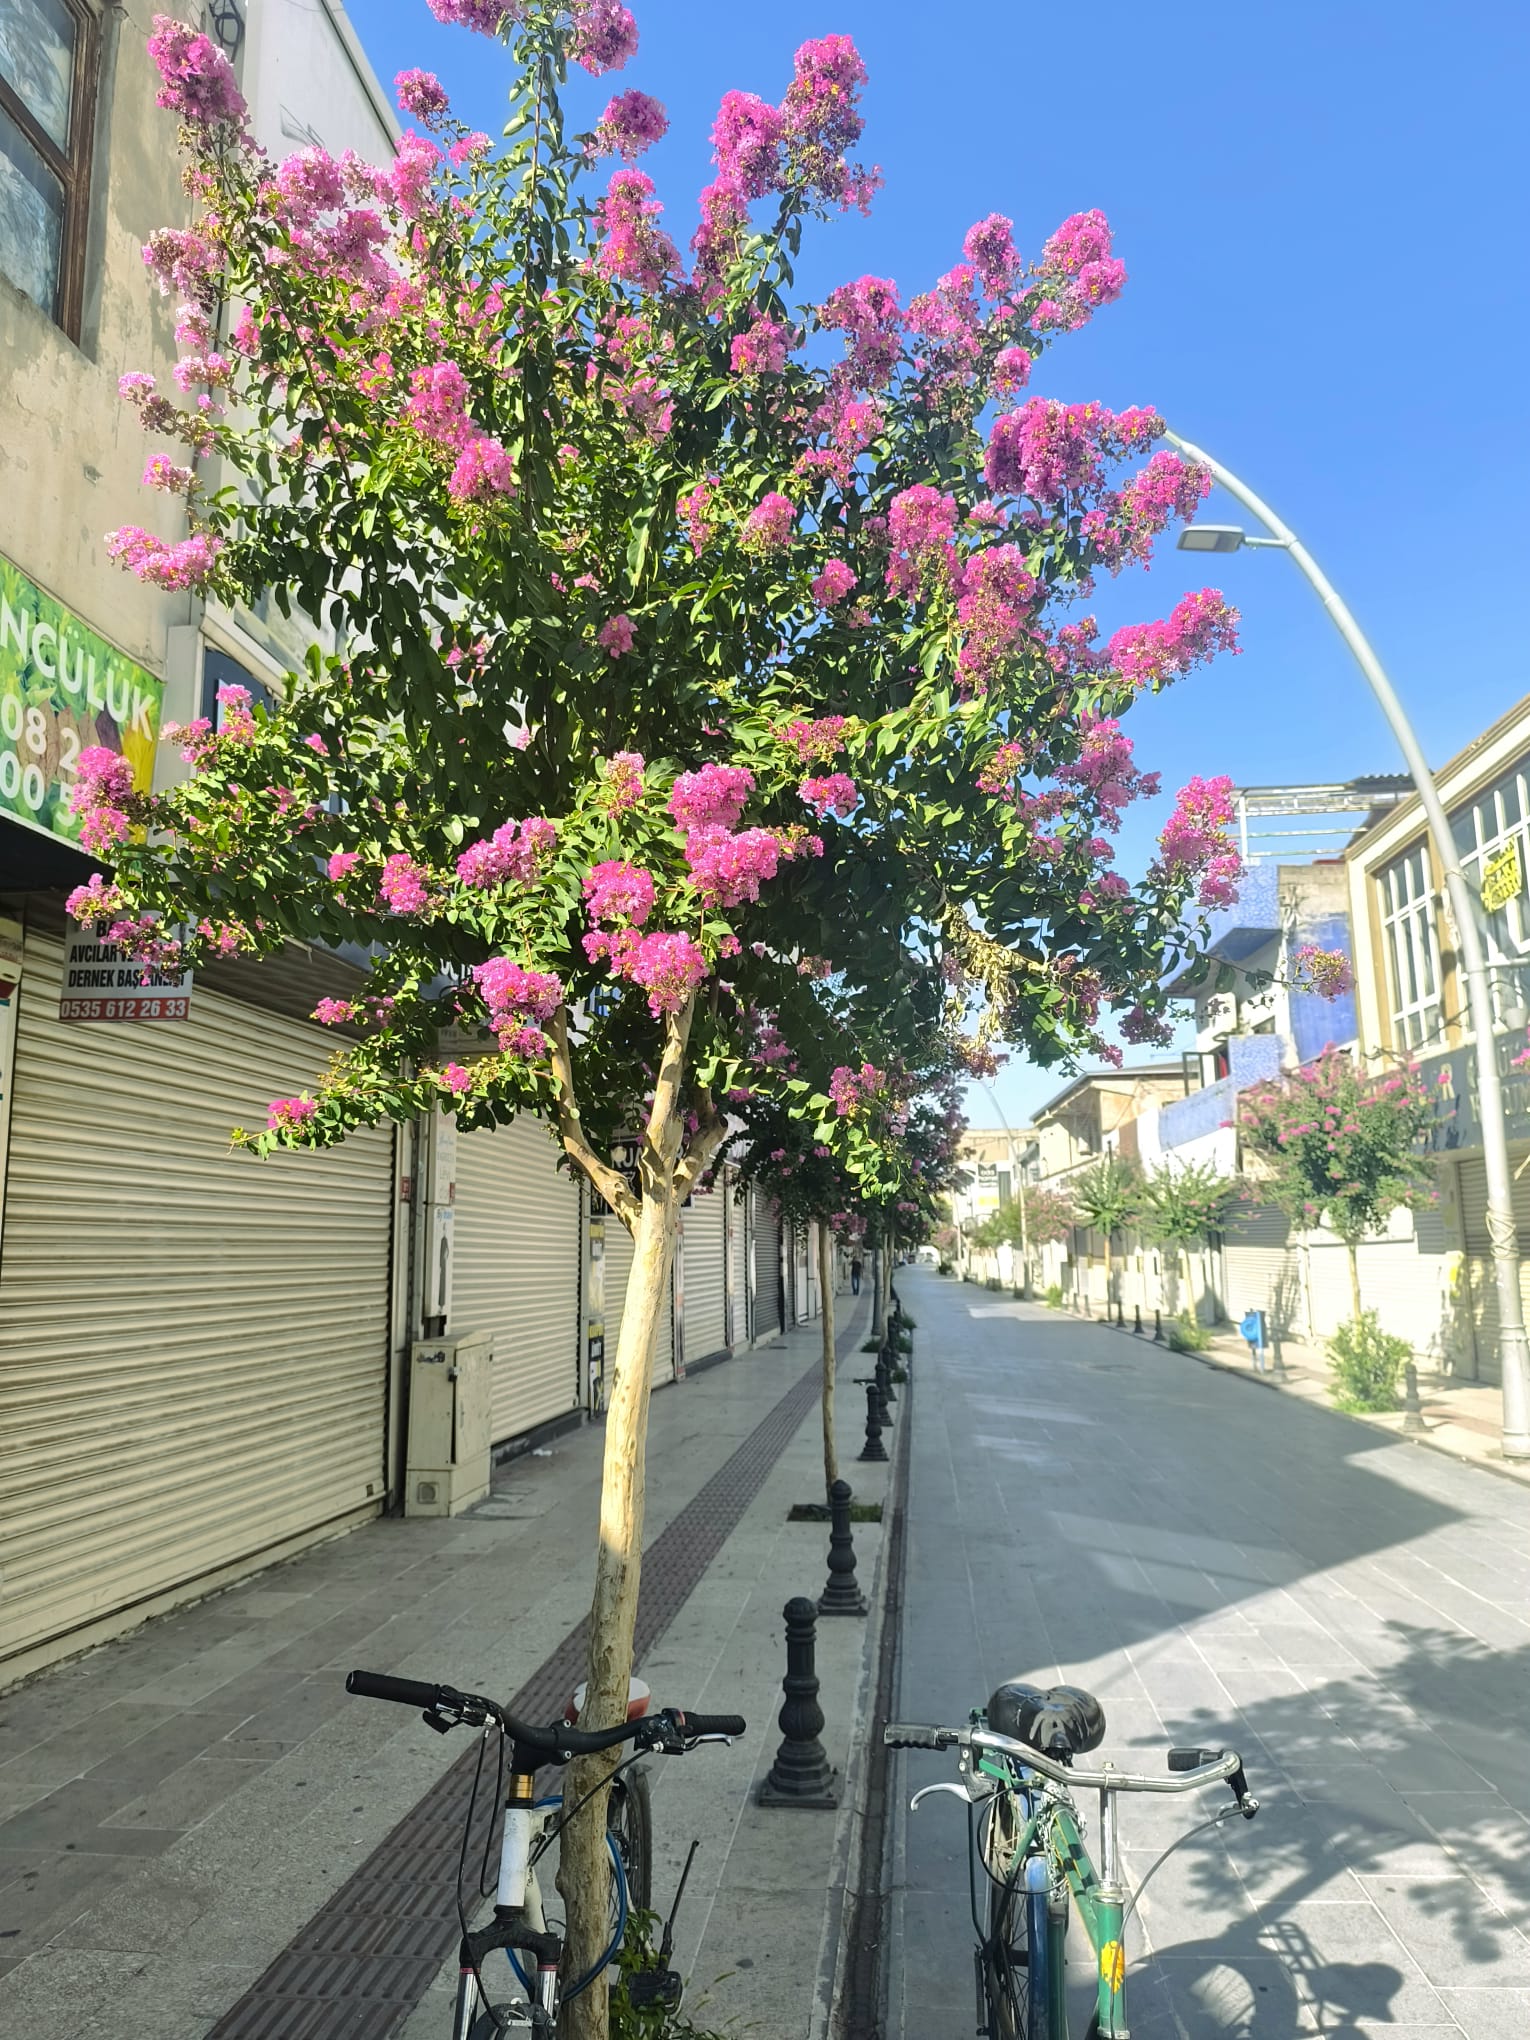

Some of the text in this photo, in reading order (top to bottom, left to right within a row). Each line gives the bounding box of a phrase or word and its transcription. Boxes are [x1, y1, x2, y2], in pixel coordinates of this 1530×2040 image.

[69, 944, 118, 963] AVCILAR
[68, 969, 114, 988] DERNEK
[61, 999, 186, 1018] 0535 612 26 33
